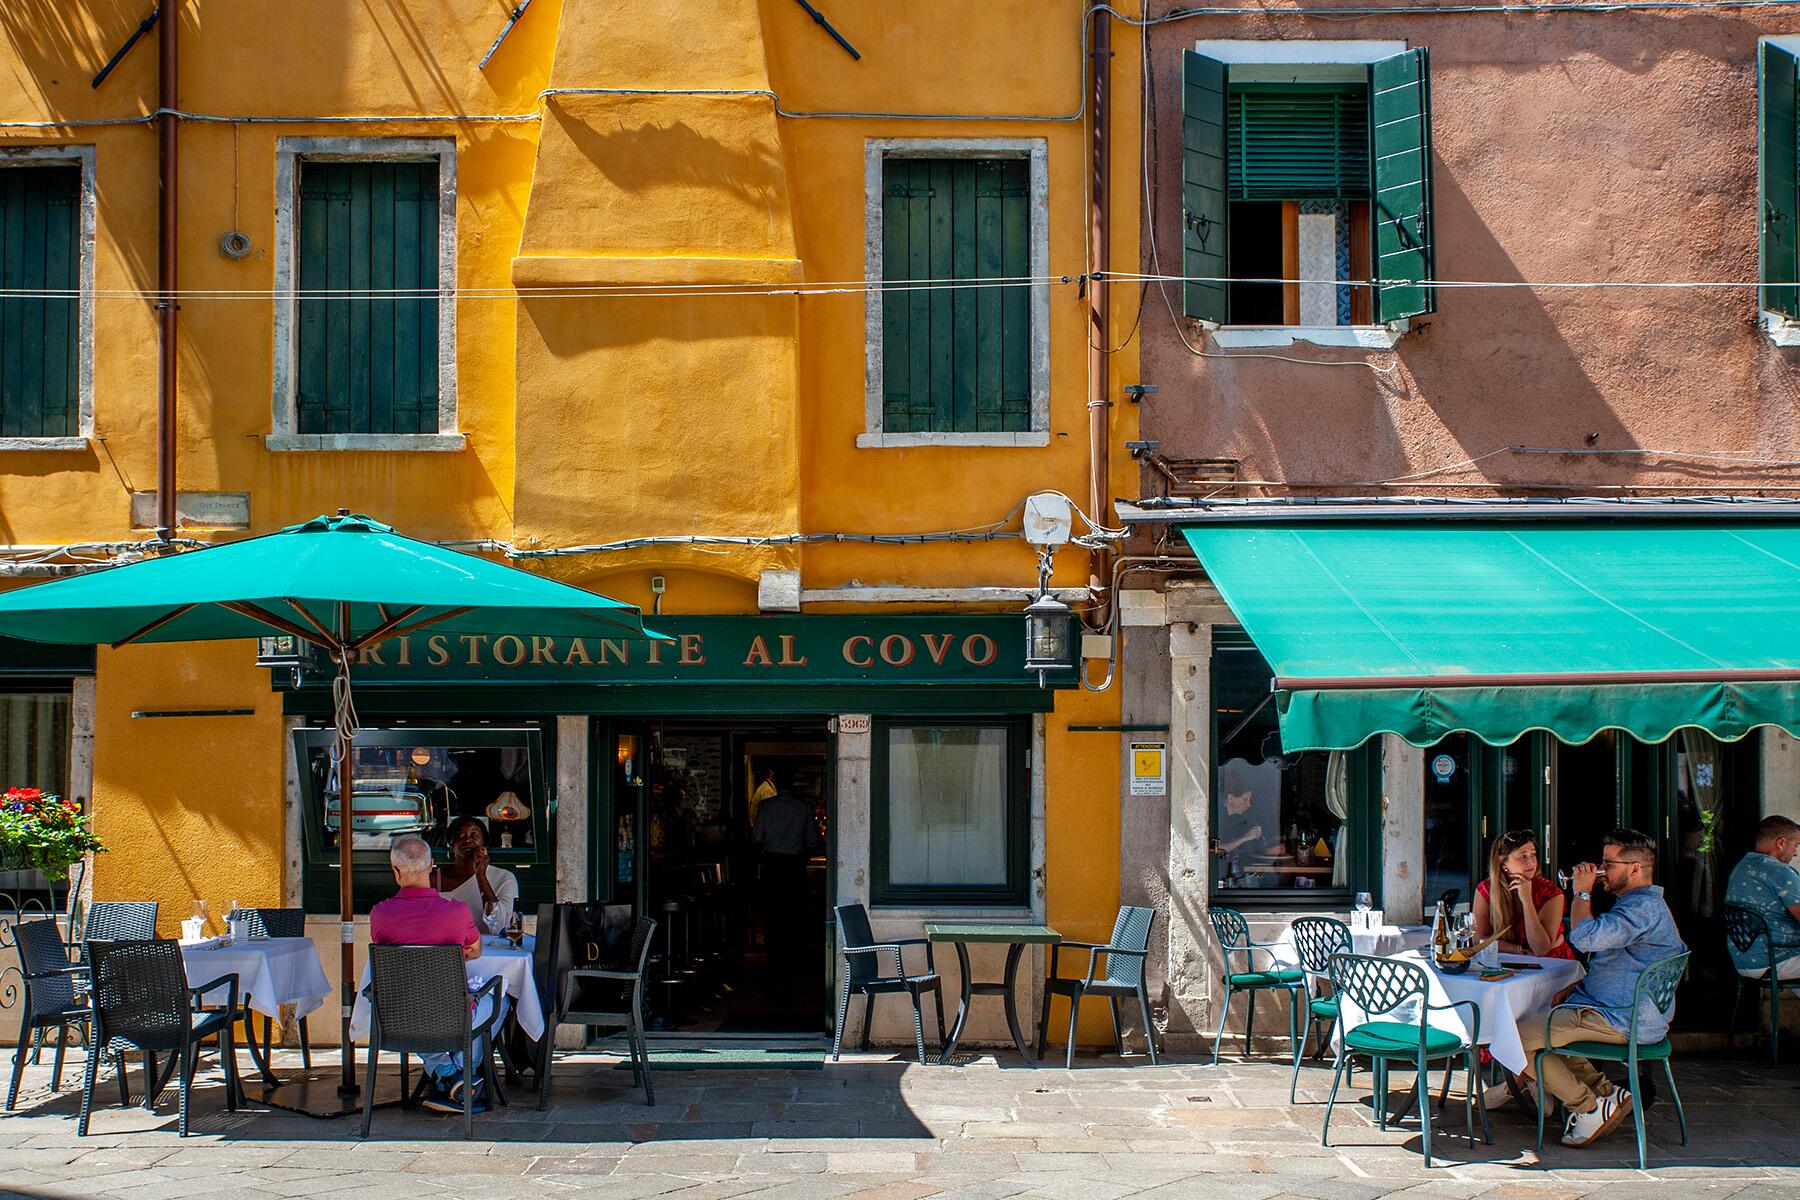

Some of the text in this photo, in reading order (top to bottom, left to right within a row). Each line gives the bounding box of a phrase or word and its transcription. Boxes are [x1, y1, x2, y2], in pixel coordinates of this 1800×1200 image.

[743, 635, 808, 667] AL
[842, 633, 997, 668] COVO
[841, 718, 869, 728] 5969
